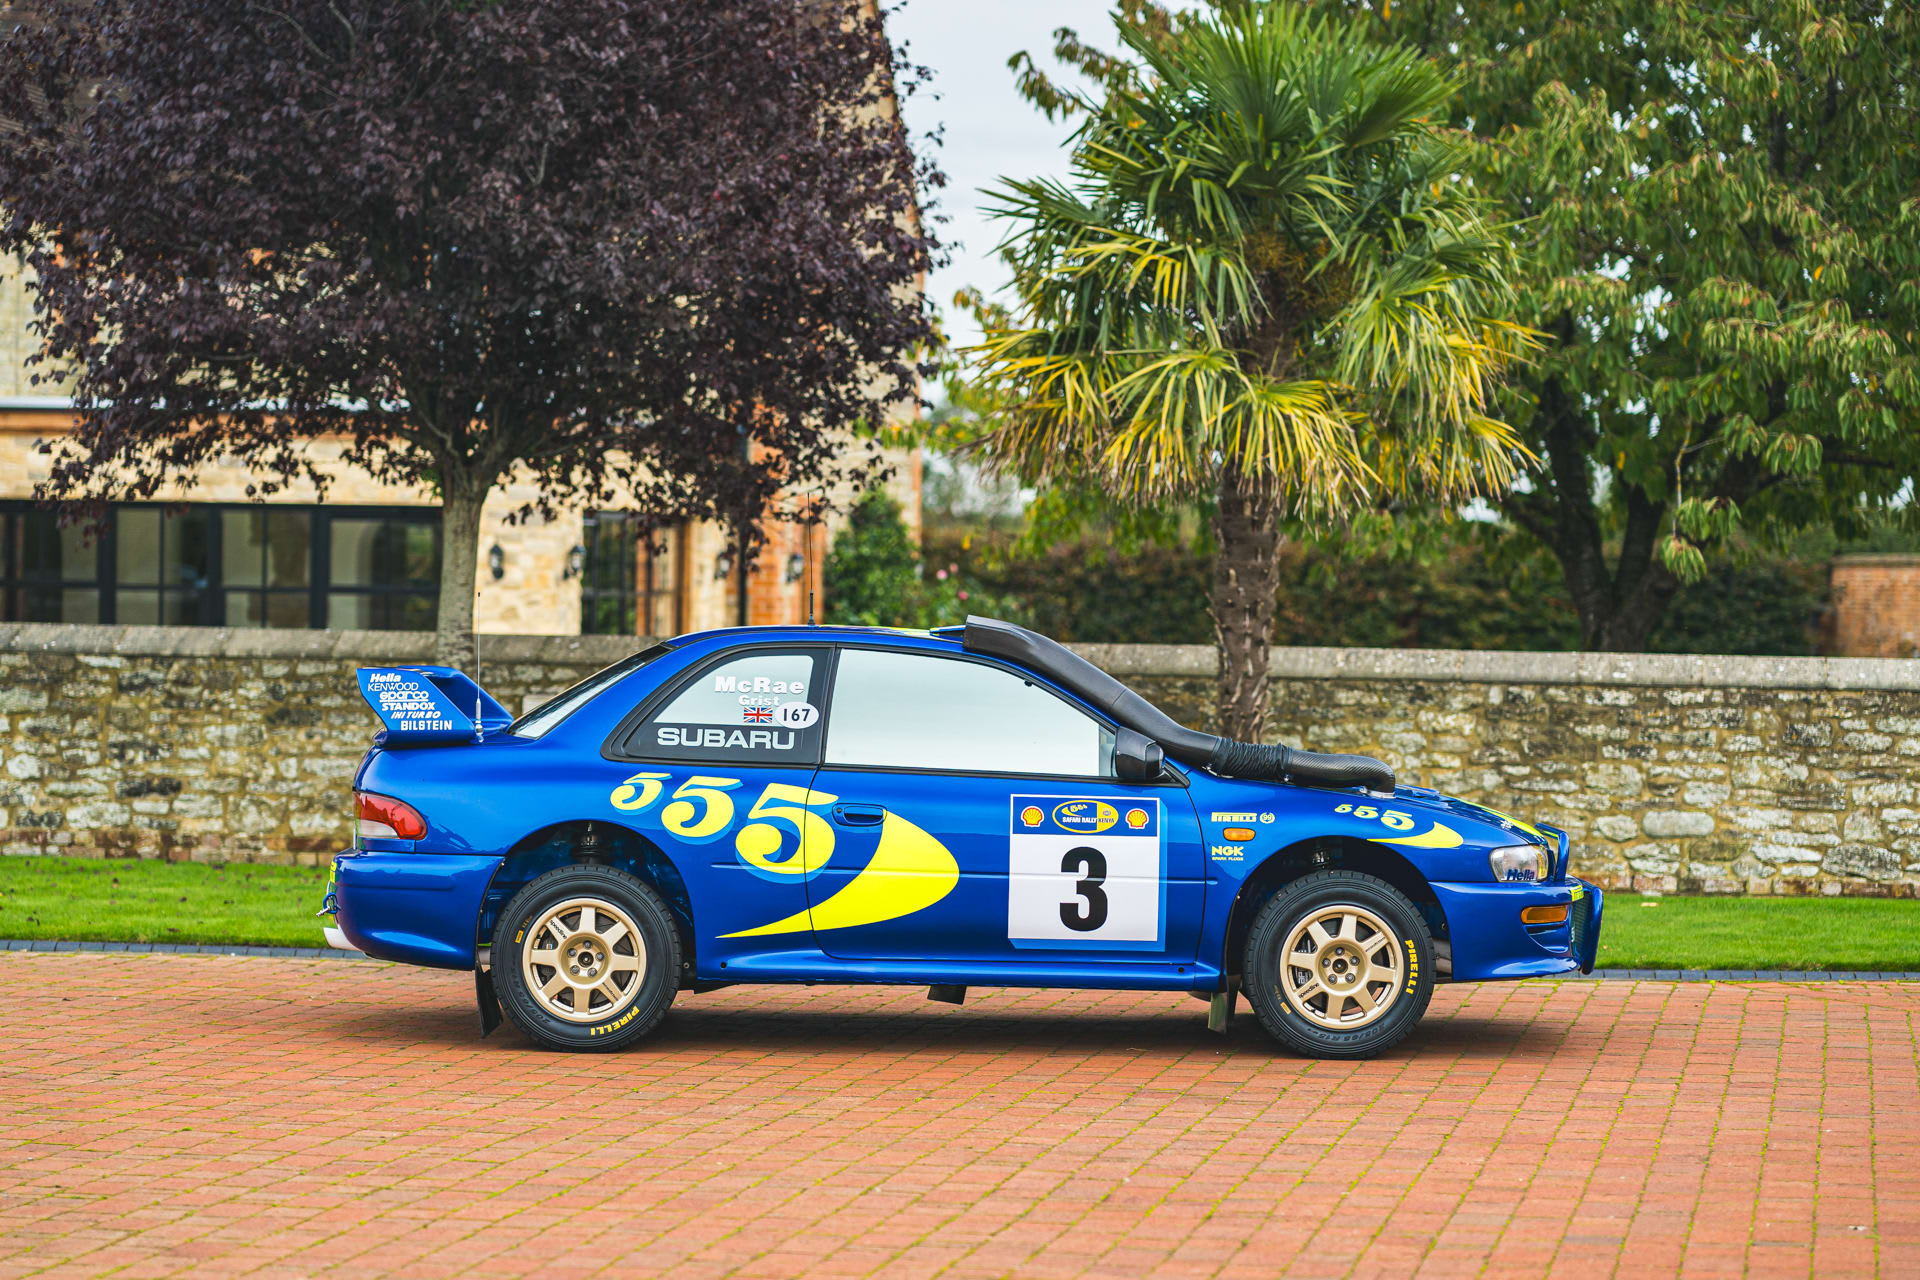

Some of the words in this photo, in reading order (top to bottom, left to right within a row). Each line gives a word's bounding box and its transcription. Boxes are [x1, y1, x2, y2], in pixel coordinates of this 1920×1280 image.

[370, 673, 402, 683] Hella
[367, 682, 419, 692] KENWOOD
[714, 676, 804, 694] McRae
[379, 691, 429, 702] sparco
[738, 695, 780, 706] Grist
[381, 702, 436, 711] STANDOX
[406, 711, 441, 719] TURBO
[783, 708, 811, 722] 167
[400, 720, 453, 731] BILSTEIN
[657, 727, 795, 750] SUBARU
[1211, 812, 1258, 823] PIRELLI
[1334, 803, 1415, 832] 555
[610, 772, 839, 880] 555
[1211, 845, 1244, 856] NGK
[1507, 868, 1535, 881] Hella
[1060, 846, 1108, 932] 3
[1404, 939, 1419, 995] PIRELLI
[590, 1005, 640, 1036] PIRELLI
